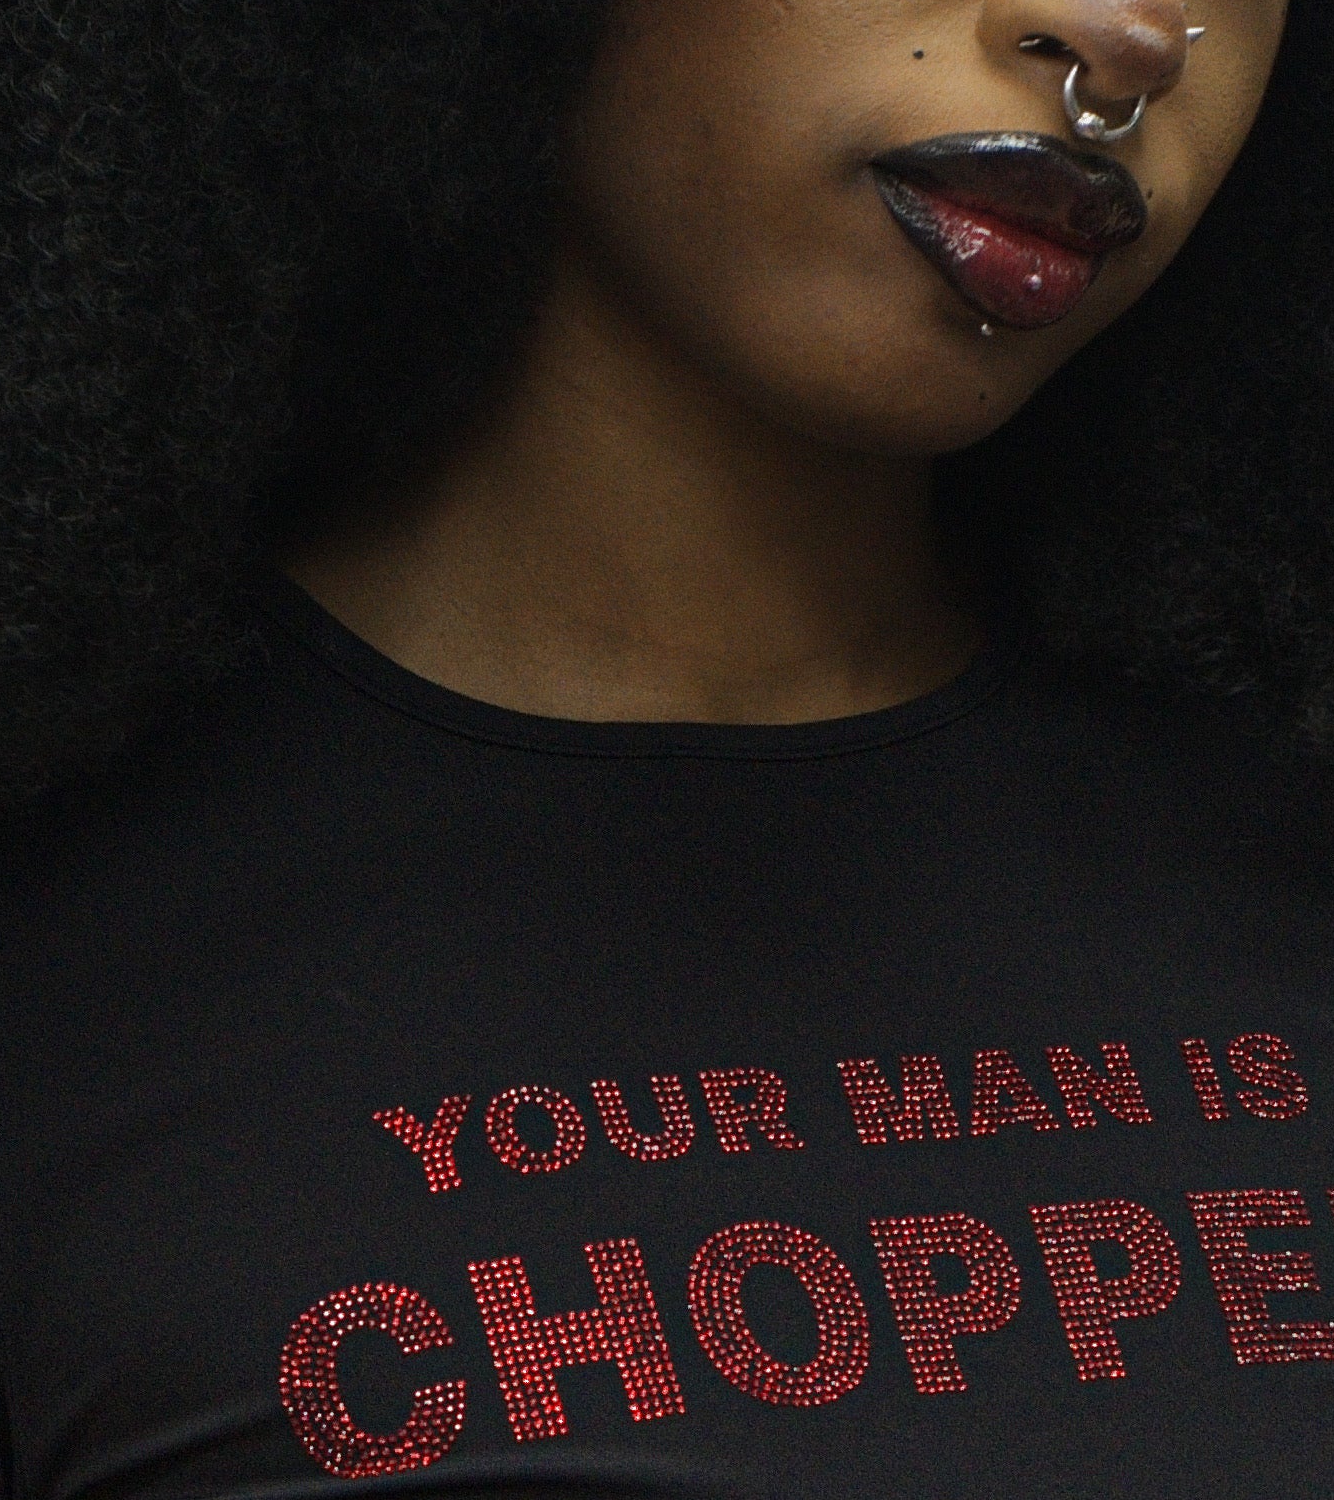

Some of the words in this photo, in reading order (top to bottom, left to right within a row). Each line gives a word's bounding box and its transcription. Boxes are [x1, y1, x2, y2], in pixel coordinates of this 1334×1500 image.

[373, 1068, 804, 1192] YOUR
[836, 1042, 1153, 1147] MAN
[1179, 1032, 1311, 1122] IS
